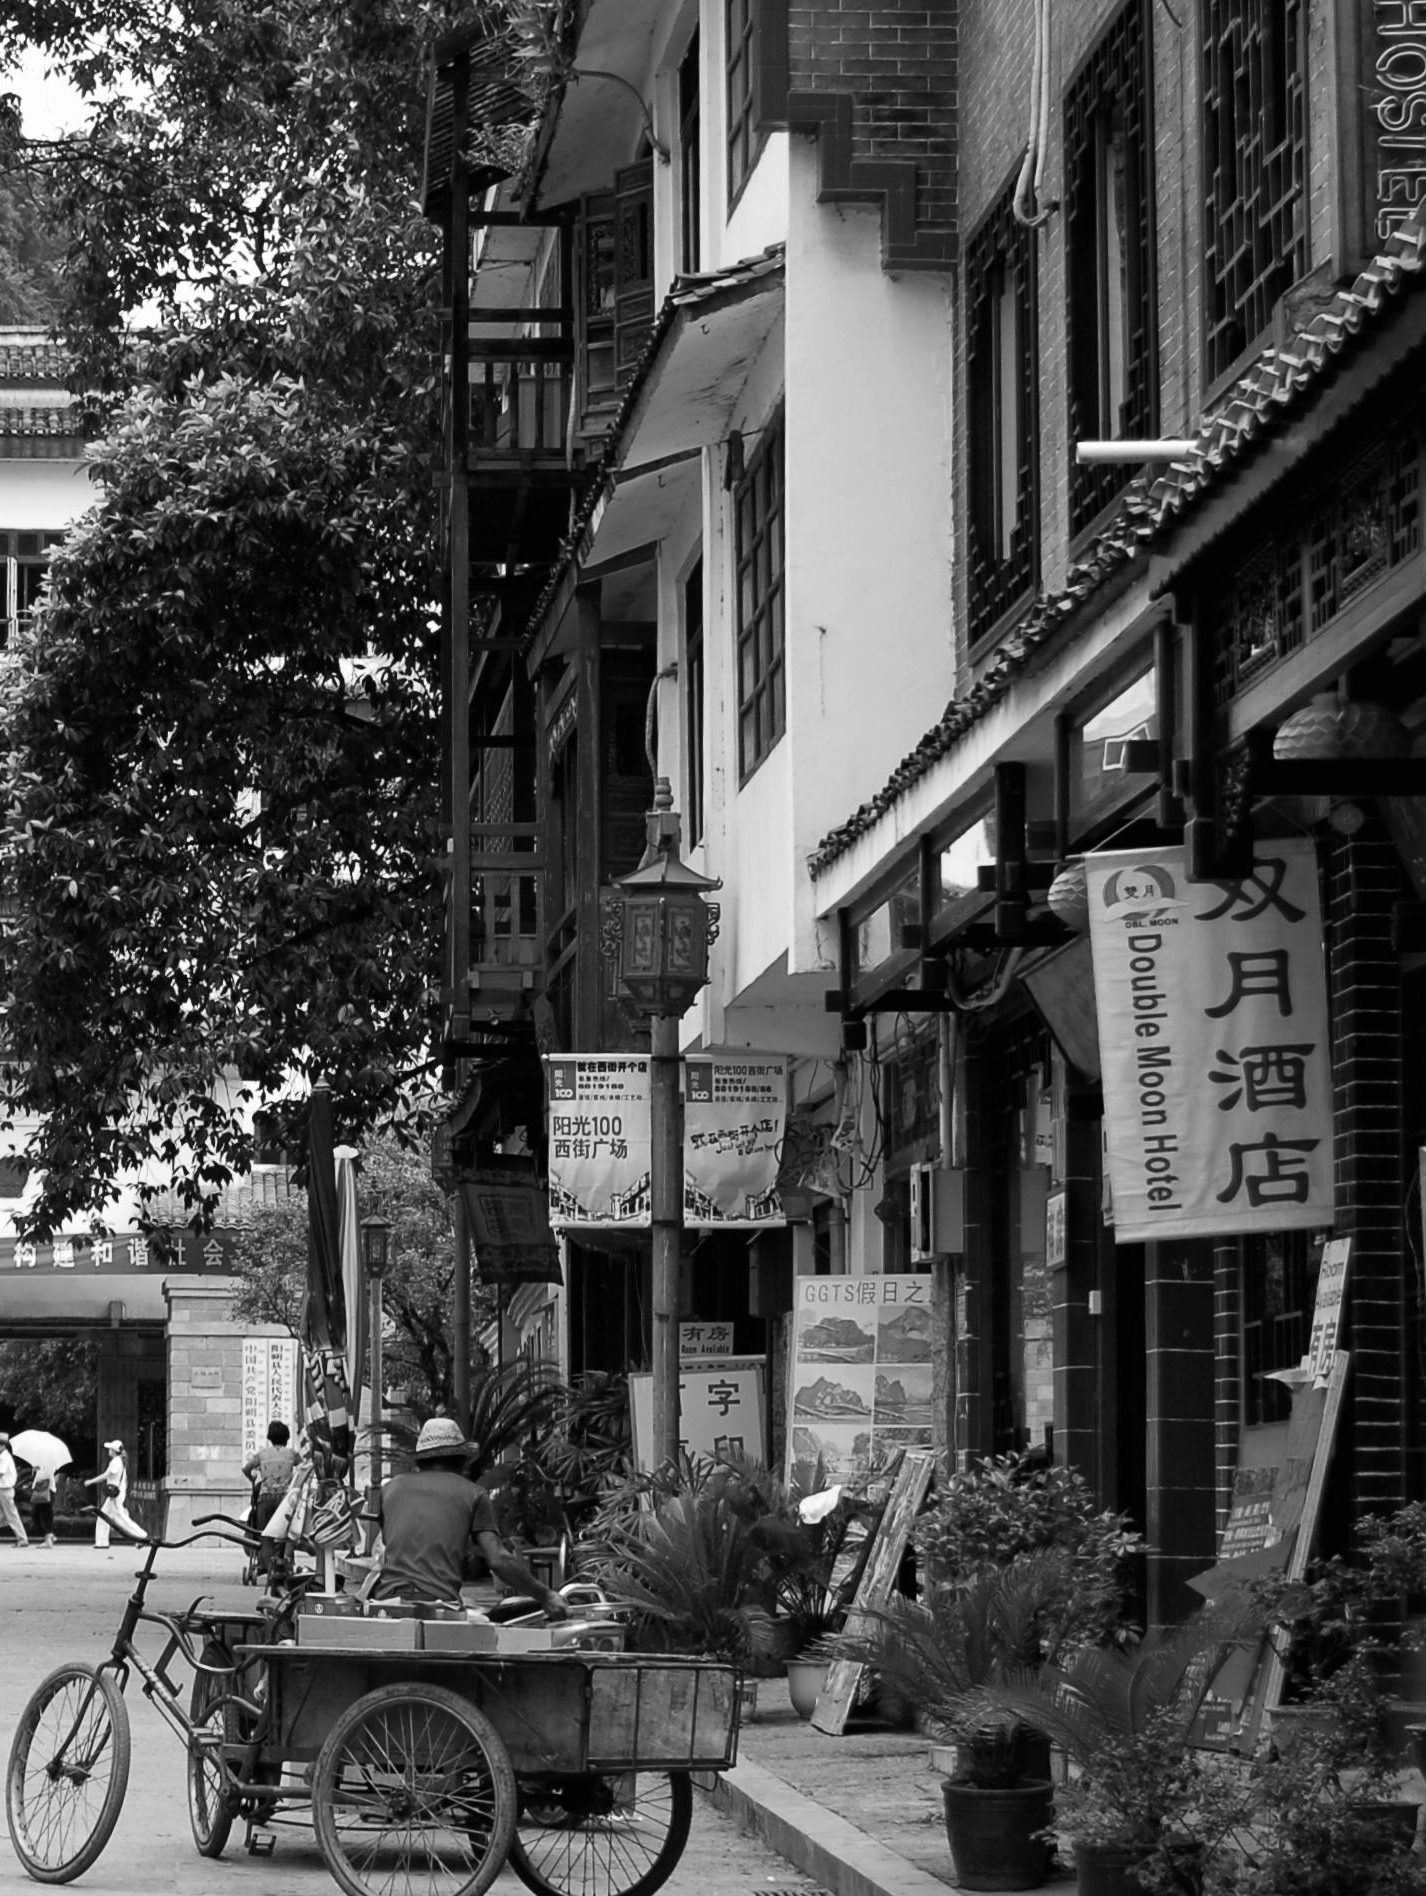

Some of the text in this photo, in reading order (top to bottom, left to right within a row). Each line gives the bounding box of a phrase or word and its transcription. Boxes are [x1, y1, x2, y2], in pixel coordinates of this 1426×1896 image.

[1149, 918, 1179, 927] MOON
[1193, 857, 1321, 1208] 双月酒店
[1127, 933, 1182, 1211] Double Moon Hotel
[554, 1088, 574, 1099] 100
[553, 1115, 622, 1136] 阳光100
[553, 1138, 628, 1159] 西街广场
[13, 1238, 224, 1268] 构建和谐社会
[682, 1326, 730, 1341] 有房
